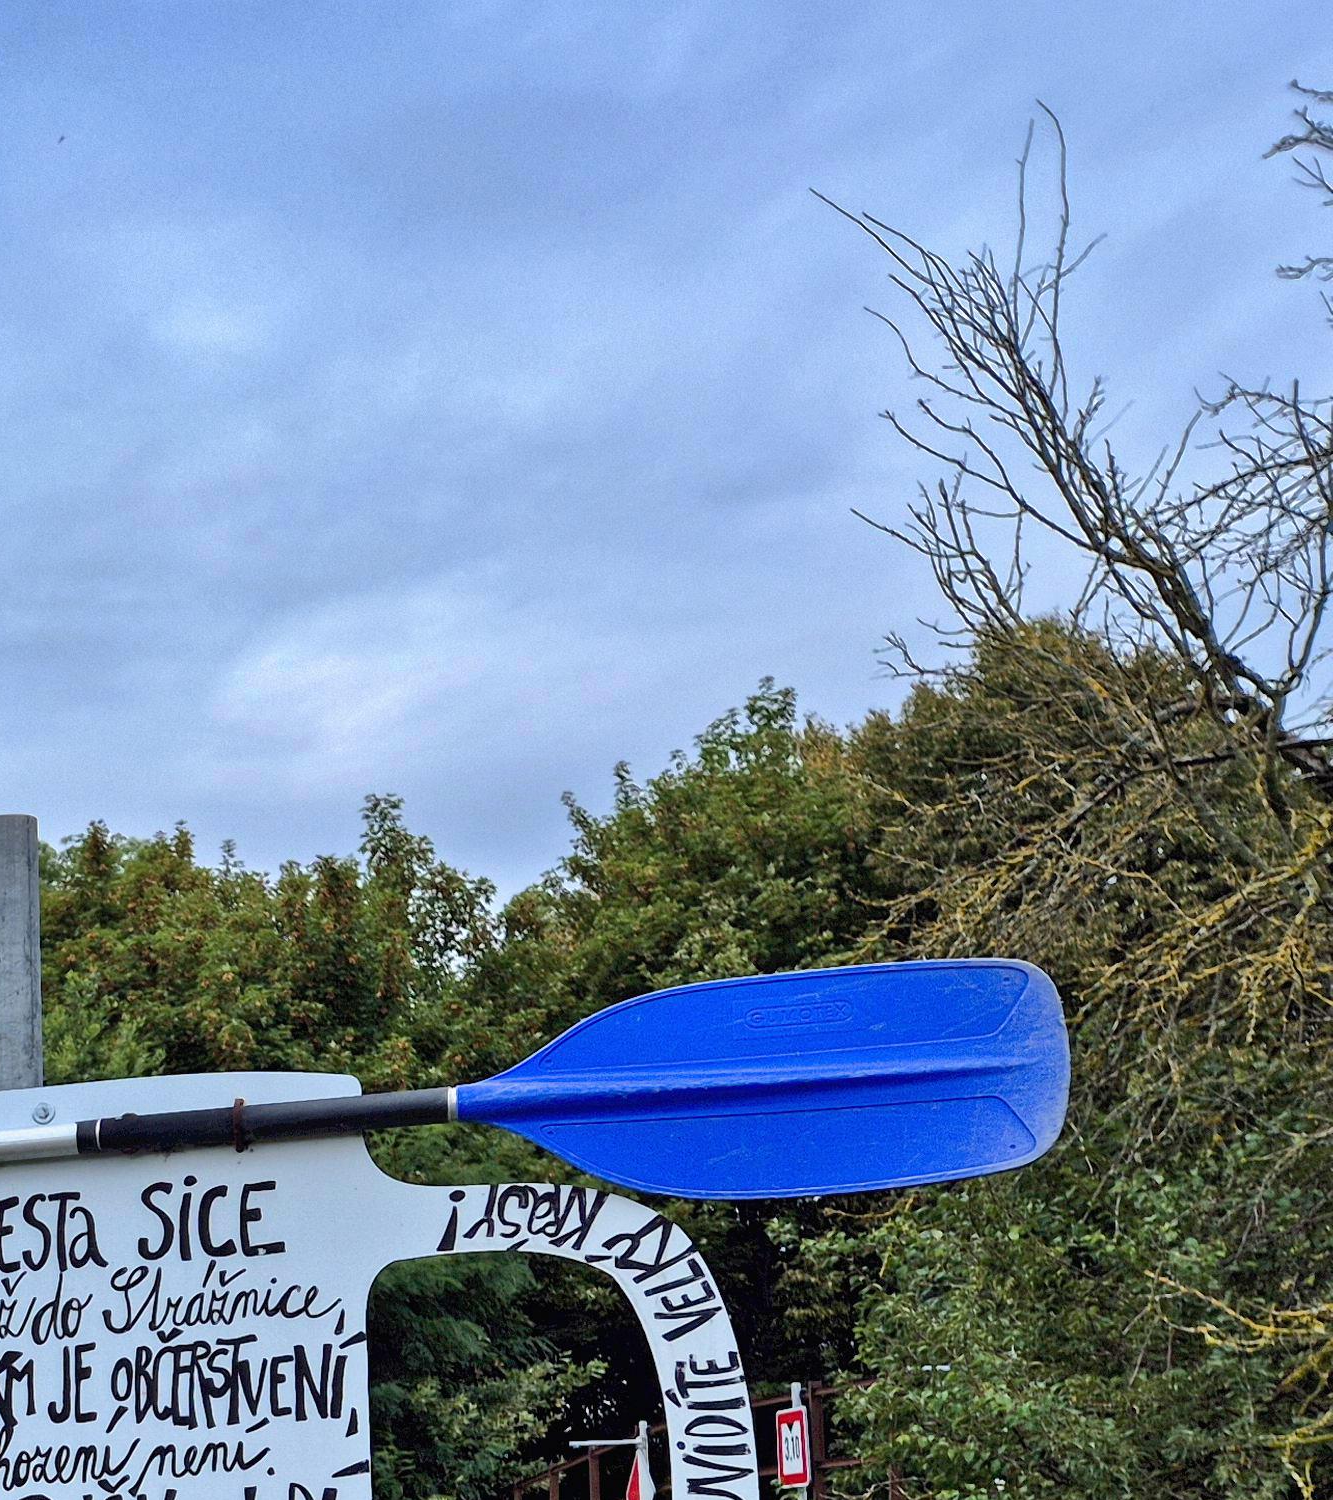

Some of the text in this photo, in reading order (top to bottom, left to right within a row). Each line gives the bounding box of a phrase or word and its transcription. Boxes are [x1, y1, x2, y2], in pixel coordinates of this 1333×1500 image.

[31, 1272, 93, 1346] do
[102, 1260, 346, 1336] Strážnice,
[47, 1342, 98, 1423] JE
[129, 1417, 275, 1496] není.
